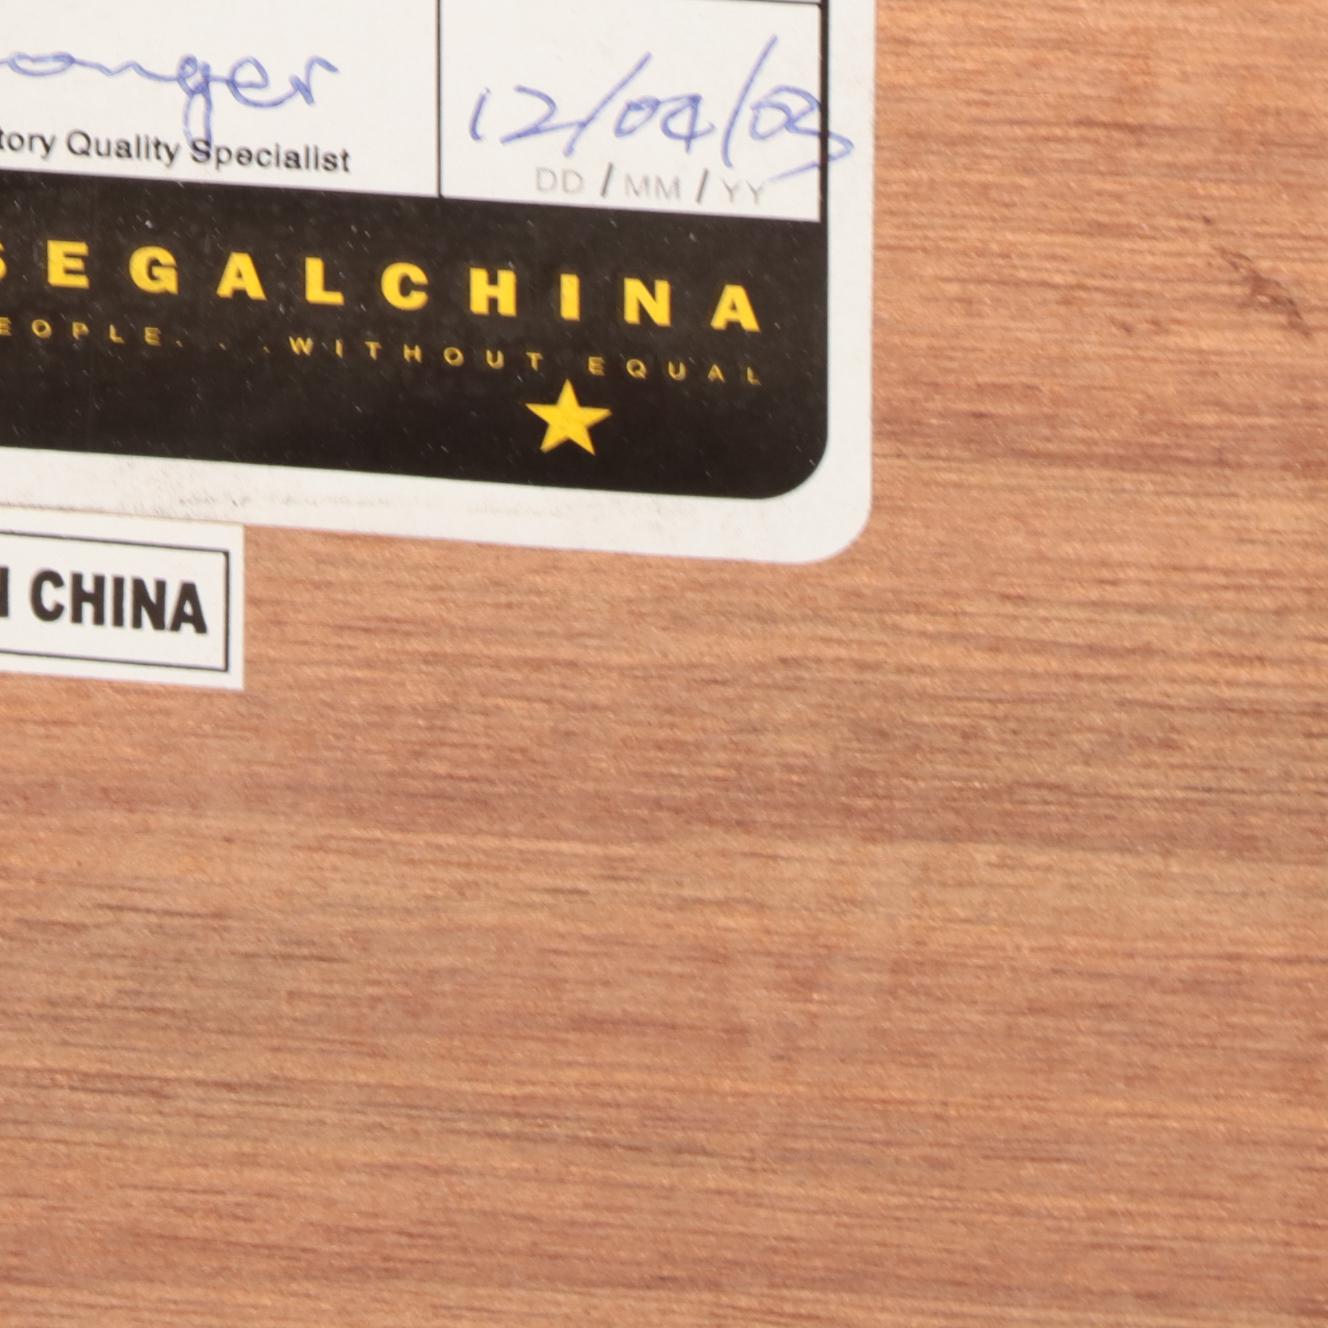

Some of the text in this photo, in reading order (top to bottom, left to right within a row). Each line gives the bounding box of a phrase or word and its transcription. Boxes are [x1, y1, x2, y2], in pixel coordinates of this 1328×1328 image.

[66, 129, 179, 165] Quality
[190, 139, 351, 173] Specialist
[288, 335, 544, 372] WITHOUT
[587, 355, 762, 387] EQUAL
[31, 569, 208, 634] CHINA
